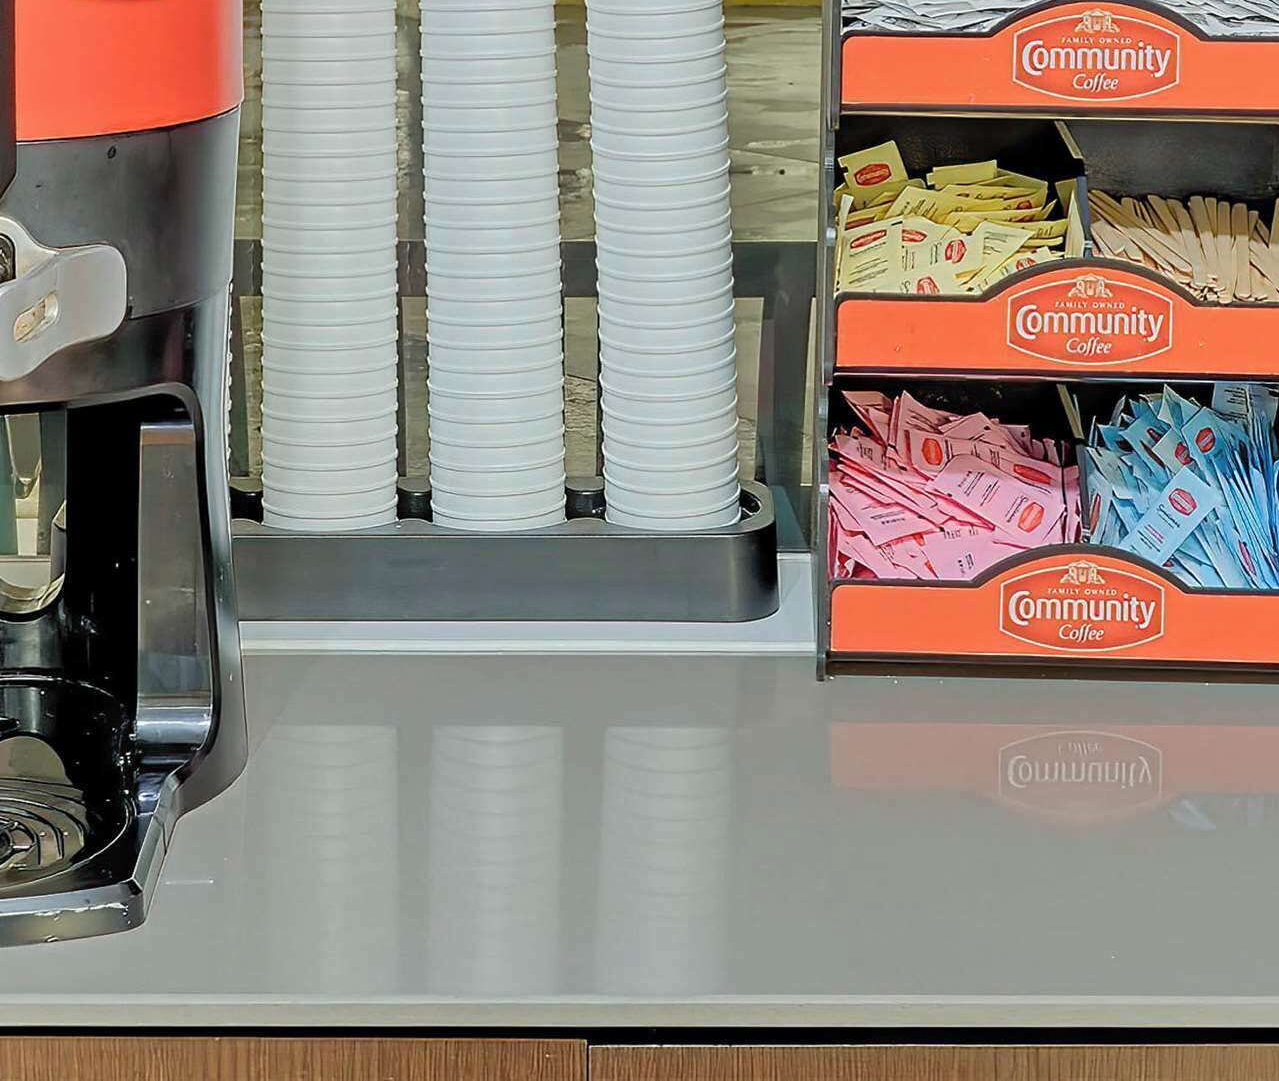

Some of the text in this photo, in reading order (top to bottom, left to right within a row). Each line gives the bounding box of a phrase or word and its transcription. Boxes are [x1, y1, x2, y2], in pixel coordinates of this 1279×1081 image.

[1022, 40, 1172, 79] Community
[1072, 72, 1120, 94] Coffee
[1016, 304, 1165, 343] Community
[1066, 336, 1113, 357] Coffee
[1008, 590, 1156, 629] Community
[1058, 622, 1106, 644] Coffee
